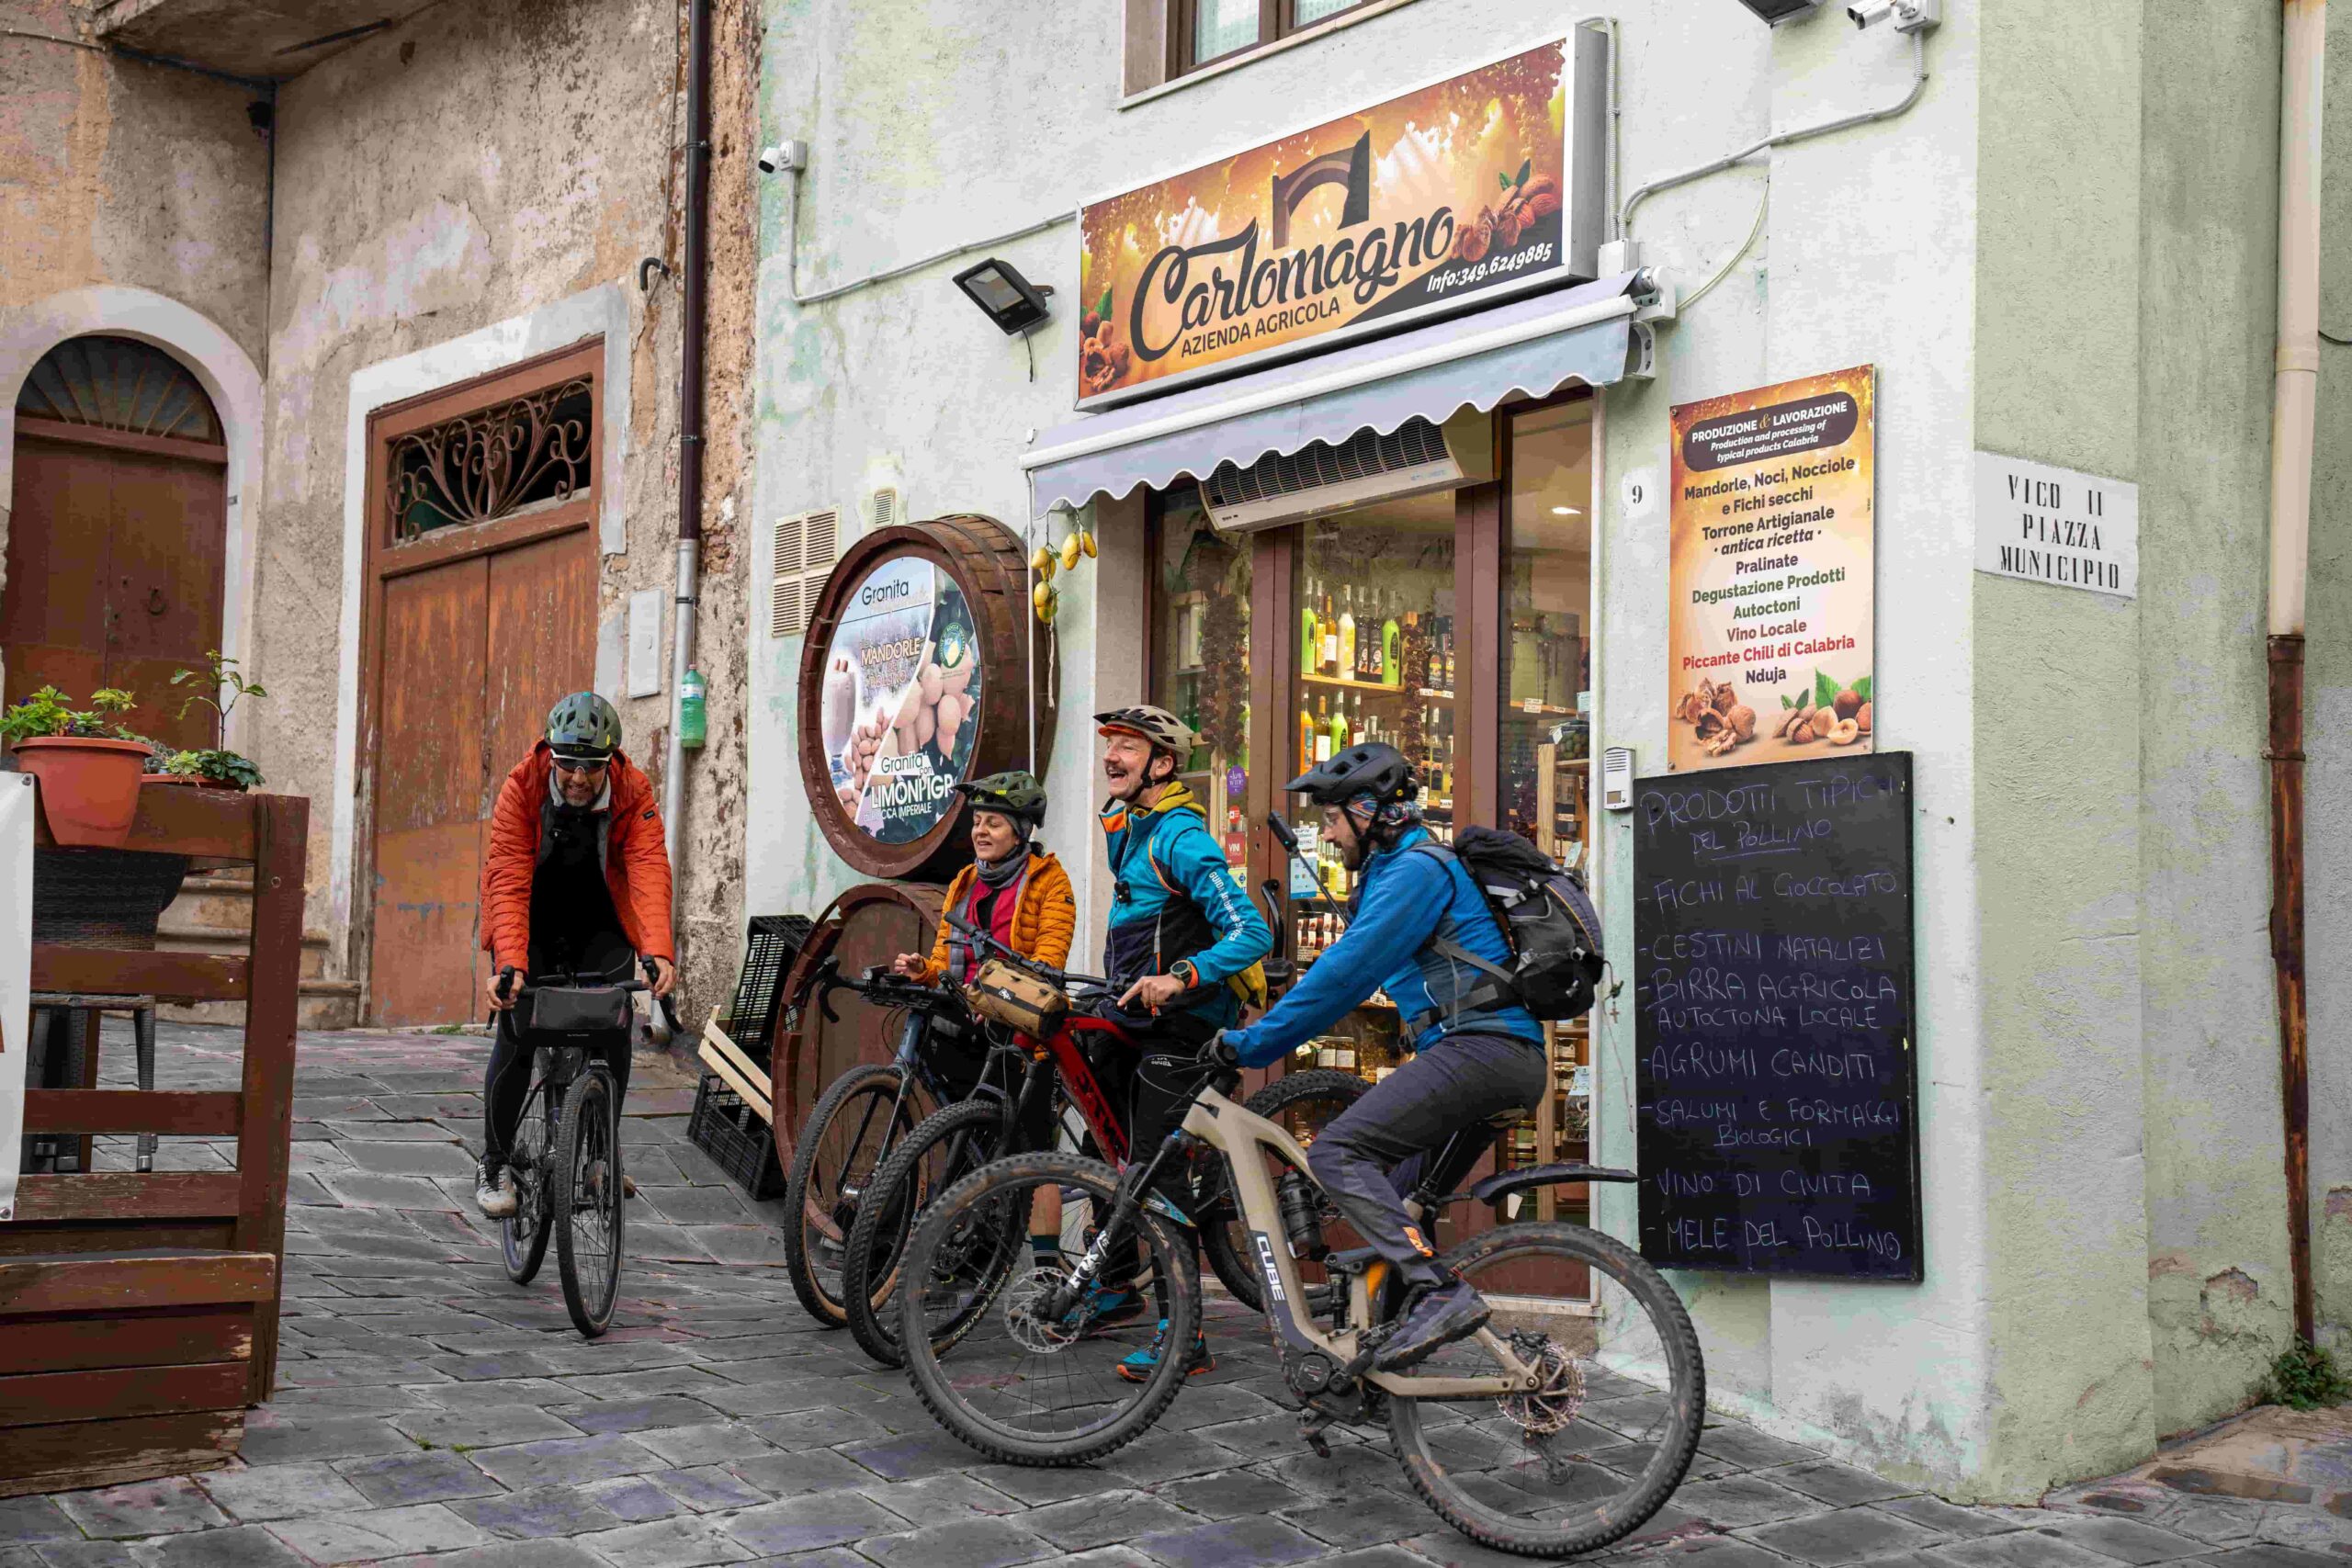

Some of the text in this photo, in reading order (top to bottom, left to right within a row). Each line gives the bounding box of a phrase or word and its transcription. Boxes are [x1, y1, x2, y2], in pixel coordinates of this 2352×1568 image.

[1426, 243, 1553, 293] Info:349.6249885
[1130, 206, 1454, 362] Carlomagno
[1182, 297, 1340, 358] AZIENDA AGRICOLA
[1692, 420, 1758, 443] PRODUZIONE
[1773, 401, 1848, 426] LAVORAZIONE
[1711, 420, 1826, 451] Production and processing of
[1717, 434, 1819, 463] typical products Calabria
[1685, 457, 1855, 500] Mandorle, Noci, Nocciole
[1632, 485, 1643, 503] 9
[1722, 486, 1814, 514] e Fichi secchi
[2008, 474, 2102, 516] VICO II
[1702, 506, 1835, 540] Torrone Artigianale
[2023, 513, 2101, 550] PIAZZA
[1721, 529, 1814, 555] antica ricetta
[1736, 555, 1798, 575] Pralinate
[2001, 546, 2119, 589] MUNICIPIO
[862, 579, 909, 605] Granita
[1692, 567, 1846, 604] Degustazione Prodotti
[1733, 596, 1801, 619] Autoctoni
[1727, 619, 1807, 642] Vino Locale
[861, 637, 921, 667] MANDORLE
[1683, 635, 1855, 670] Piccante Chili di Calabria
[1747, 667, 1787, 684] Nduja
[882, 752, 923, 773] Granita
[920, 766, 933, 774] con
[1794, 775, 1894, 809] TIPICI
[898, 802, 933, 818] IMPERIALE
[1690, 819, 1832, 855] DEL POLLINO
[1736, 875, 1762, 900] AL
[1778, 934, 1885, 961] NATALIZI
[1758, 973, 1896, 1000] AGRICOLA
[1657, 1005, 1882, 1032] AUTOCTONA LOCALE
[1771, 1049, 1875, 1079] CANDITI
[1759, 1100, 1771, 1121] E
[1787, 1098, 1899, 1128] FORMAGGI
[1714, 1124, 1811, 1146] BIOLOGICI
[1736, 1173, 1760, 1196] DI
[1781, 1170, 1870, 1196] CIVITA
[1745, 1219, 1788, 1247] DEL
[1803, 1215, 1901, 1260] POLLINO
[1256, 1235, 1285, 1301] CUBE
